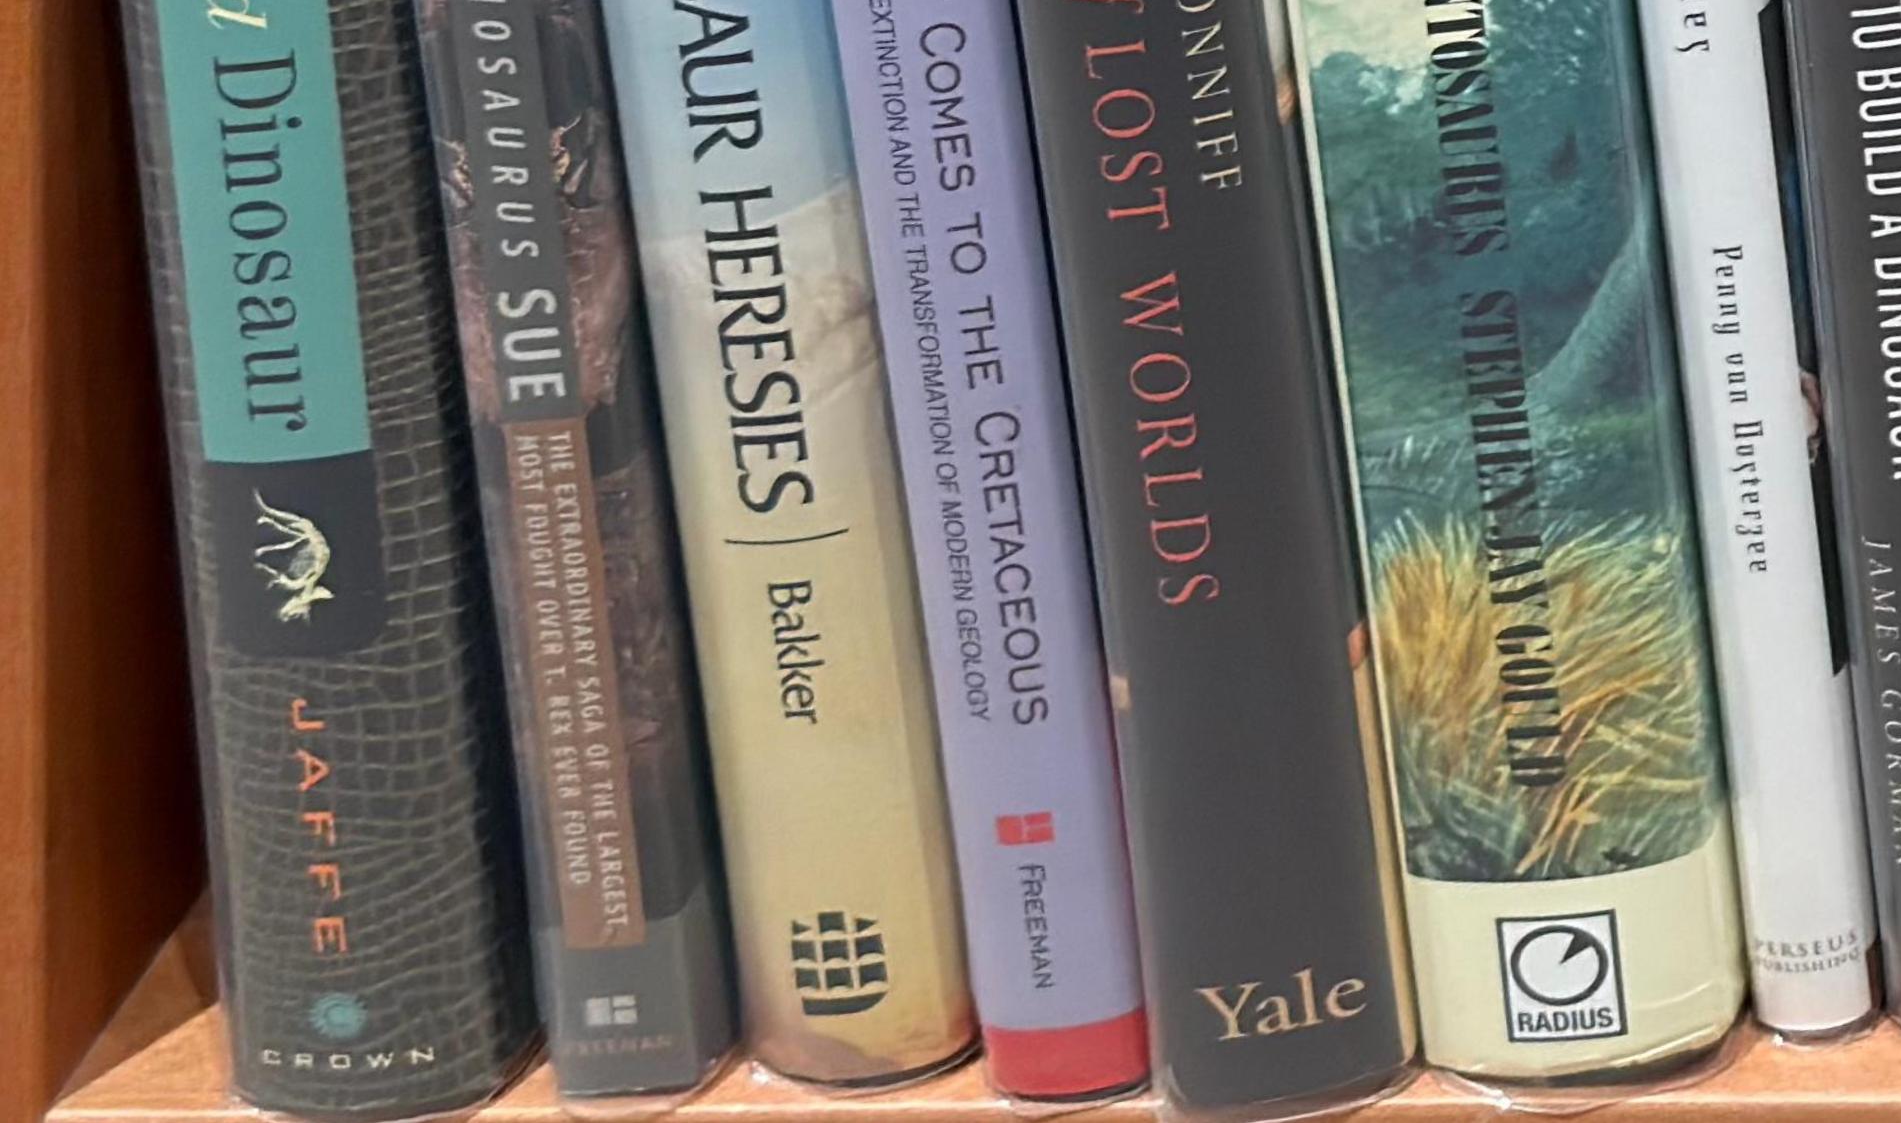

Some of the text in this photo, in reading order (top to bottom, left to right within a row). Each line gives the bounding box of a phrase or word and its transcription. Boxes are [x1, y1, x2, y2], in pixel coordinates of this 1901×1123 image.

[919, 23, 977, 194] COMES
[1084, 39, 1173, 232] LOST
[888, 140, 917, 186] AND
[213, 49, 310, 432] Dinosaur
[895, 192, 925, 237] THE
[946, 210, 988, 276] TO
[497, 289, 567, 403] SUE
[699, 186, 815, 514] HERESIES
[903, 243, 955, 457] TRANSFORMATION
[958, 295, 1004, 390] THE
[1119, 270, 1221, 608] WORLDS
[1459, 289, 1542, 518] STEPHEN
[1712, 244, 1768, 574] Penny van Oosterzee
[514, 435, 545, 492] MOST
[551, 431, 575, 472] THE
[933, 461, 961, 494] OF
[525, 503, 557, 589] FOUGHT
[555, 482, 598, 667] EXTRAORDINARY
[939, 499, 975, 603] MODERN
[973, 410, 1050, 727] CRETACEOUS
[1483, 526, 1550, 610] JAY
[536, 599, 566, 656] OVER
[1860, 536, 1901, 665] JAMES
[767, 579, 822, 726] Bakker
[954, 607, 992, 723] GEOLOGY
[548, 695, 574, 736] REX
[577, 676, 607, 734] SAGA
[1495, 622, 1566, 788] GOULD
[552, 746, 582, 799] EVER
[585, 744, 610, 767] OF
[591, 781, 617, 820] THE
[290, 699, 348, 956] JAFFE
[562, 810, 592, 886] FOUND
[1016, 862, 1056, 991] FREEMAN
[1194, 967, 1368, 1043] Yale
[1516, 1007, 1614, 1034] RADIUS
[261, 1045, 437, 1071] CROWN
